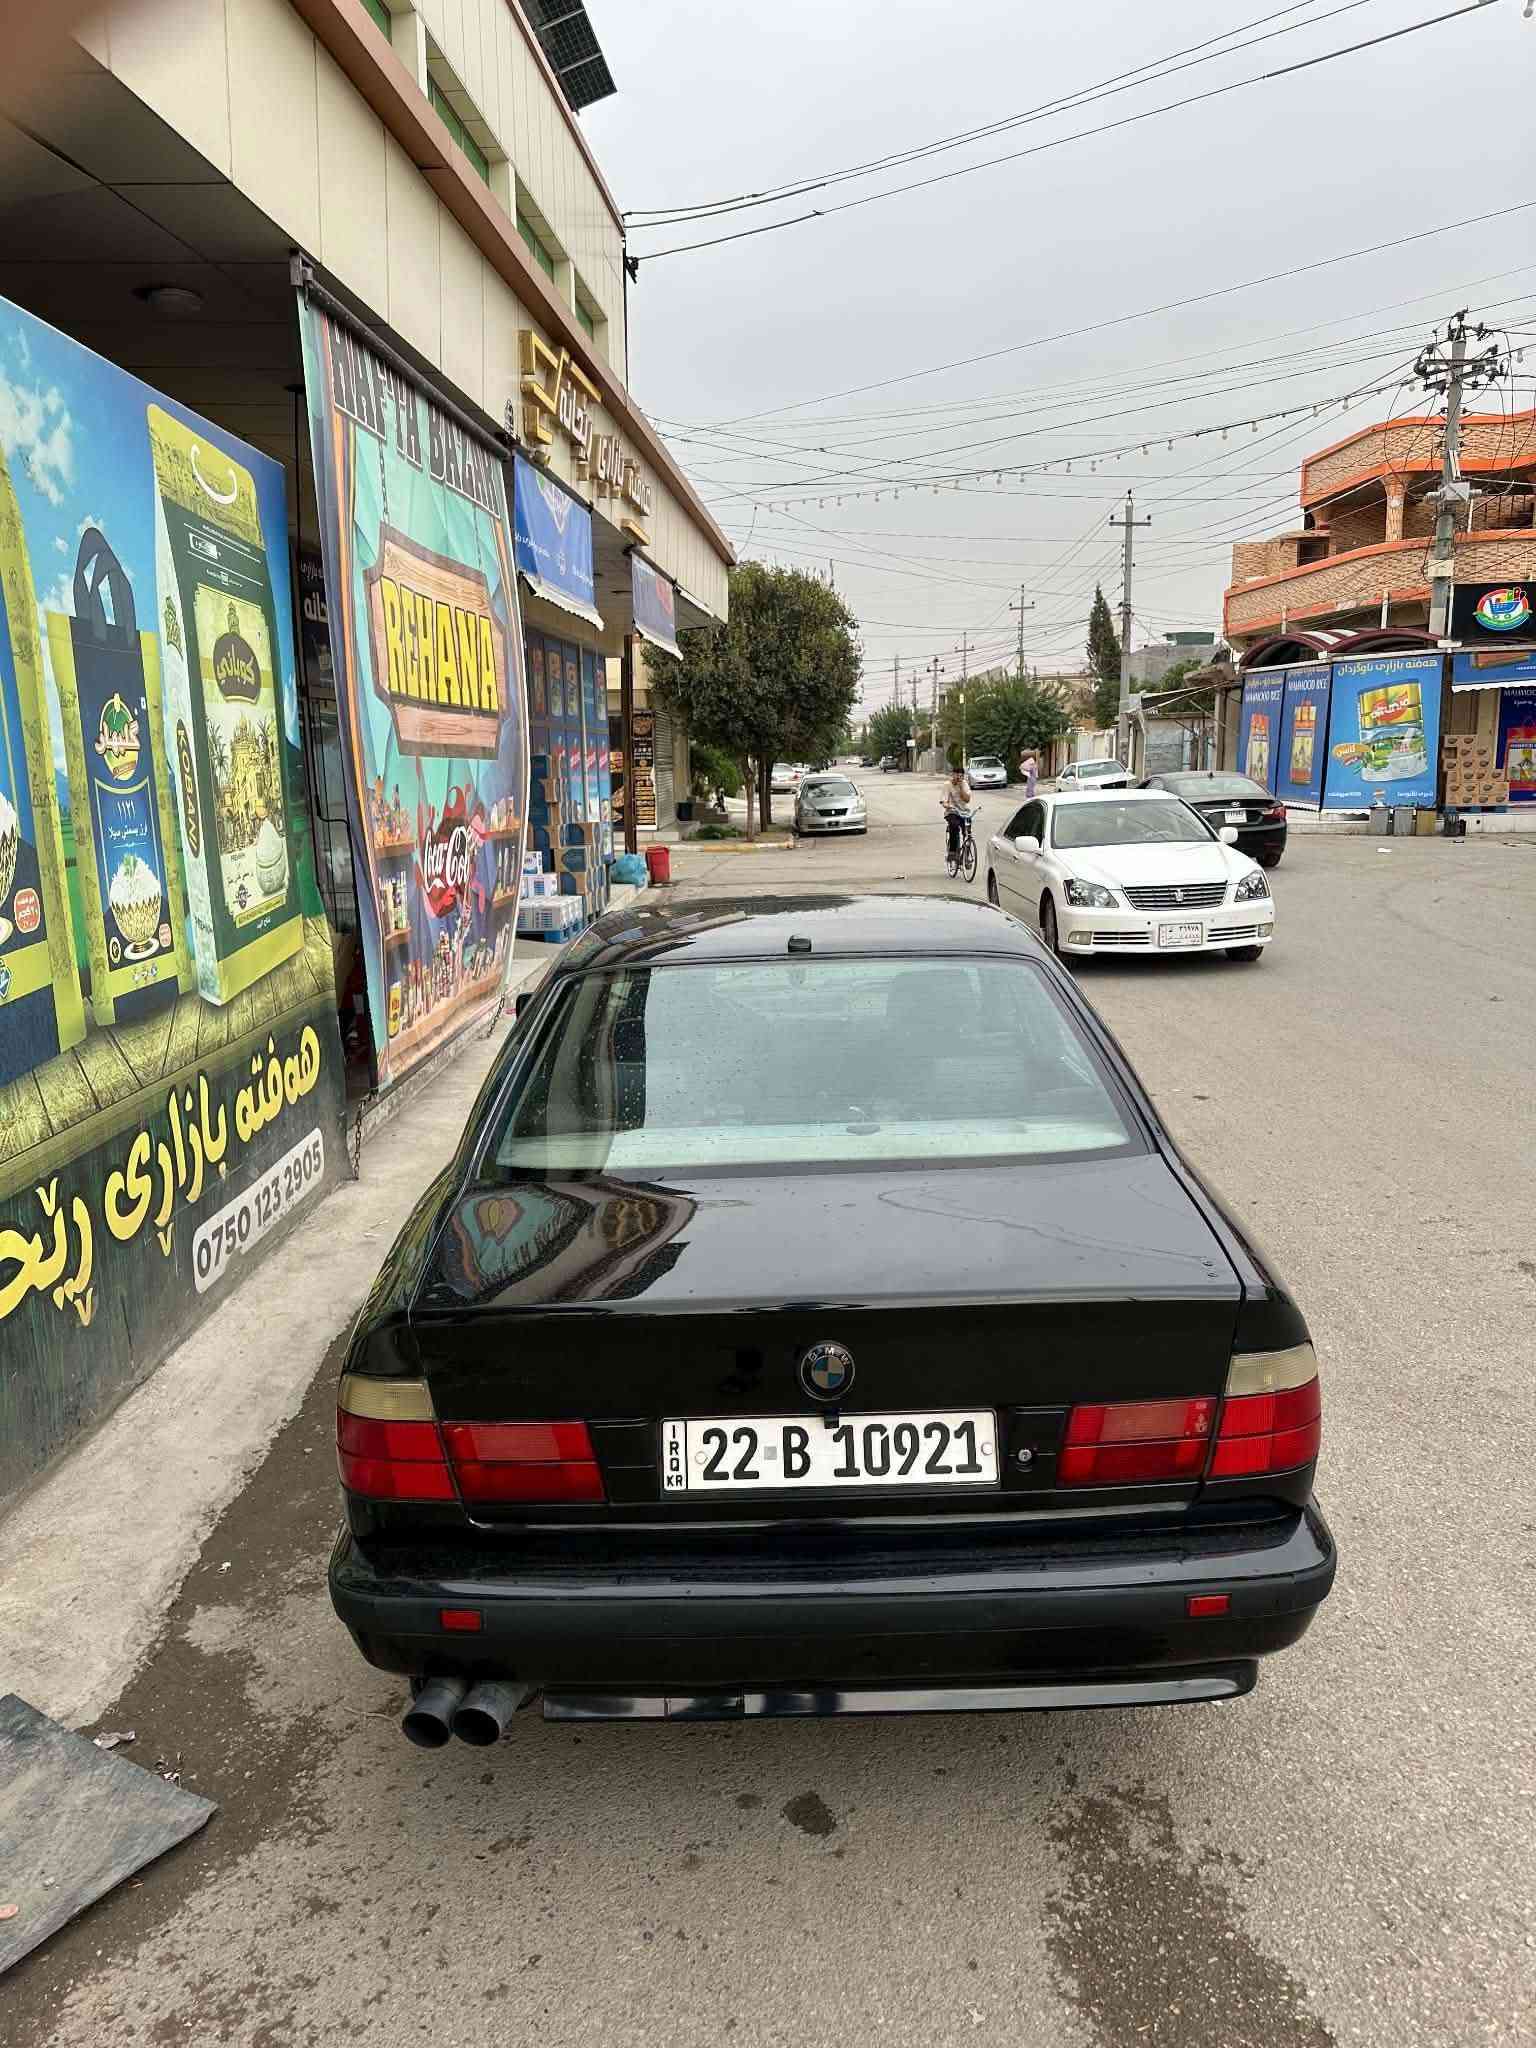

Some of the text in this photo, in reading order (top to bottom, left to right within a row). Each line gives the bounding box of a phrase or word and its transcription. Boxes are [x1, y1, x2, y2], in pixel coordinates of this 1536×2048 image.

[380, 574, 500, 712] REHANA
[178, 729, 198, 851] KOBANI
[197, 1139, 321, 1278] 0750 123 2905
[666, 1474, 683, 1489] KR
[702, 1420, 983, 1480] 22 B 10921
